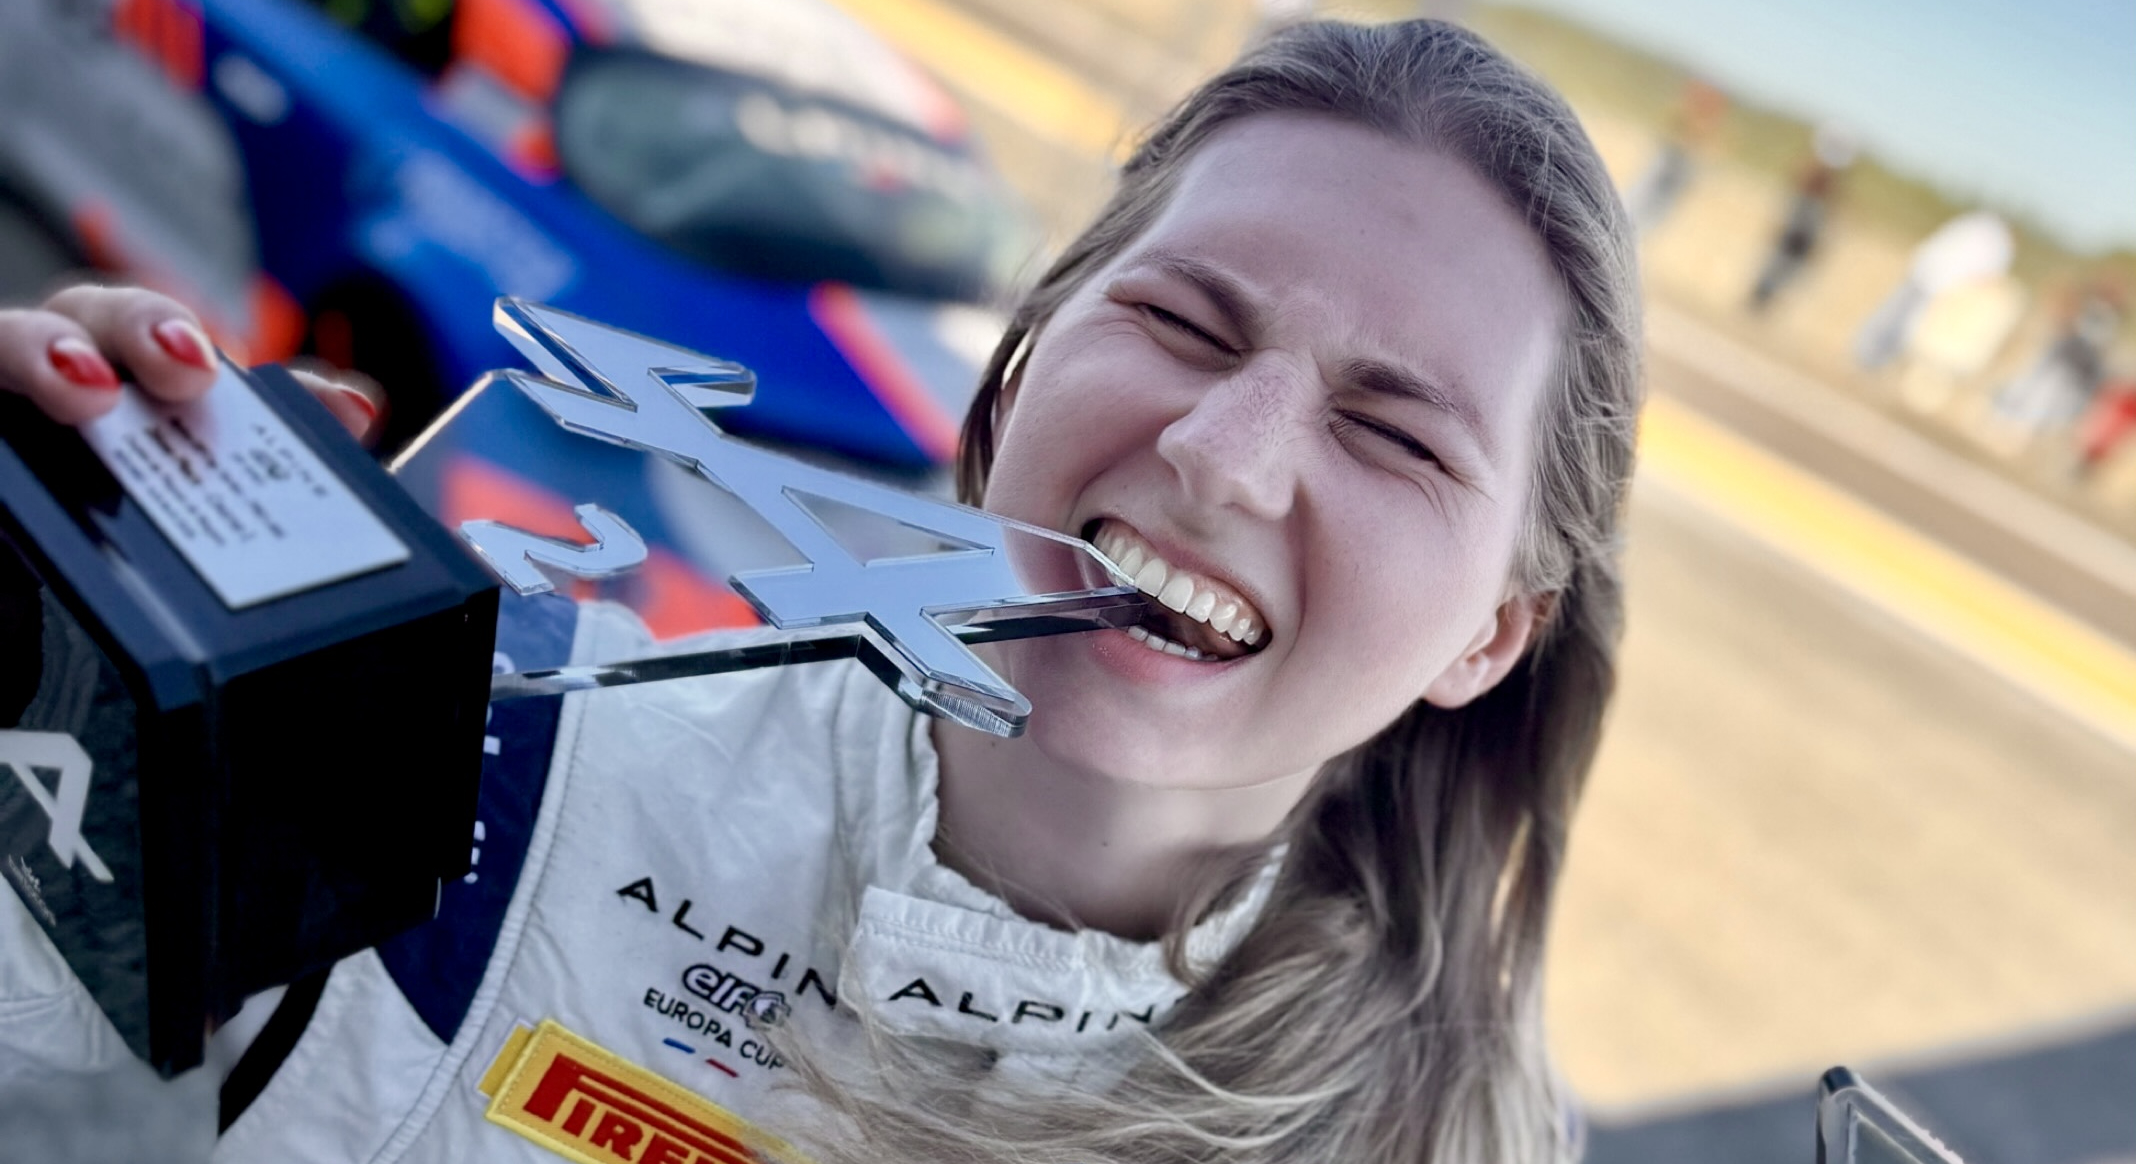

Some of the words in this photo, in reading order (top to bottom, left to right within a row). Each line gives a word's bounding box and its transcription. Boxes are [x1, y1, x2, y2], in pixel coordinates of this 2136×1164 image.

[457, 503, 649, 596] 2
[615, 876, 837, 1011] ALPIN
[643, 987, 733, 1048] EUROPA
[738, 1039, 785, 1071] CUP
[682, 963, 764, 1018] elf
[888, 977, 1155, 1033] ALPIN
[522, 1052, 765, 1164] PIRE
